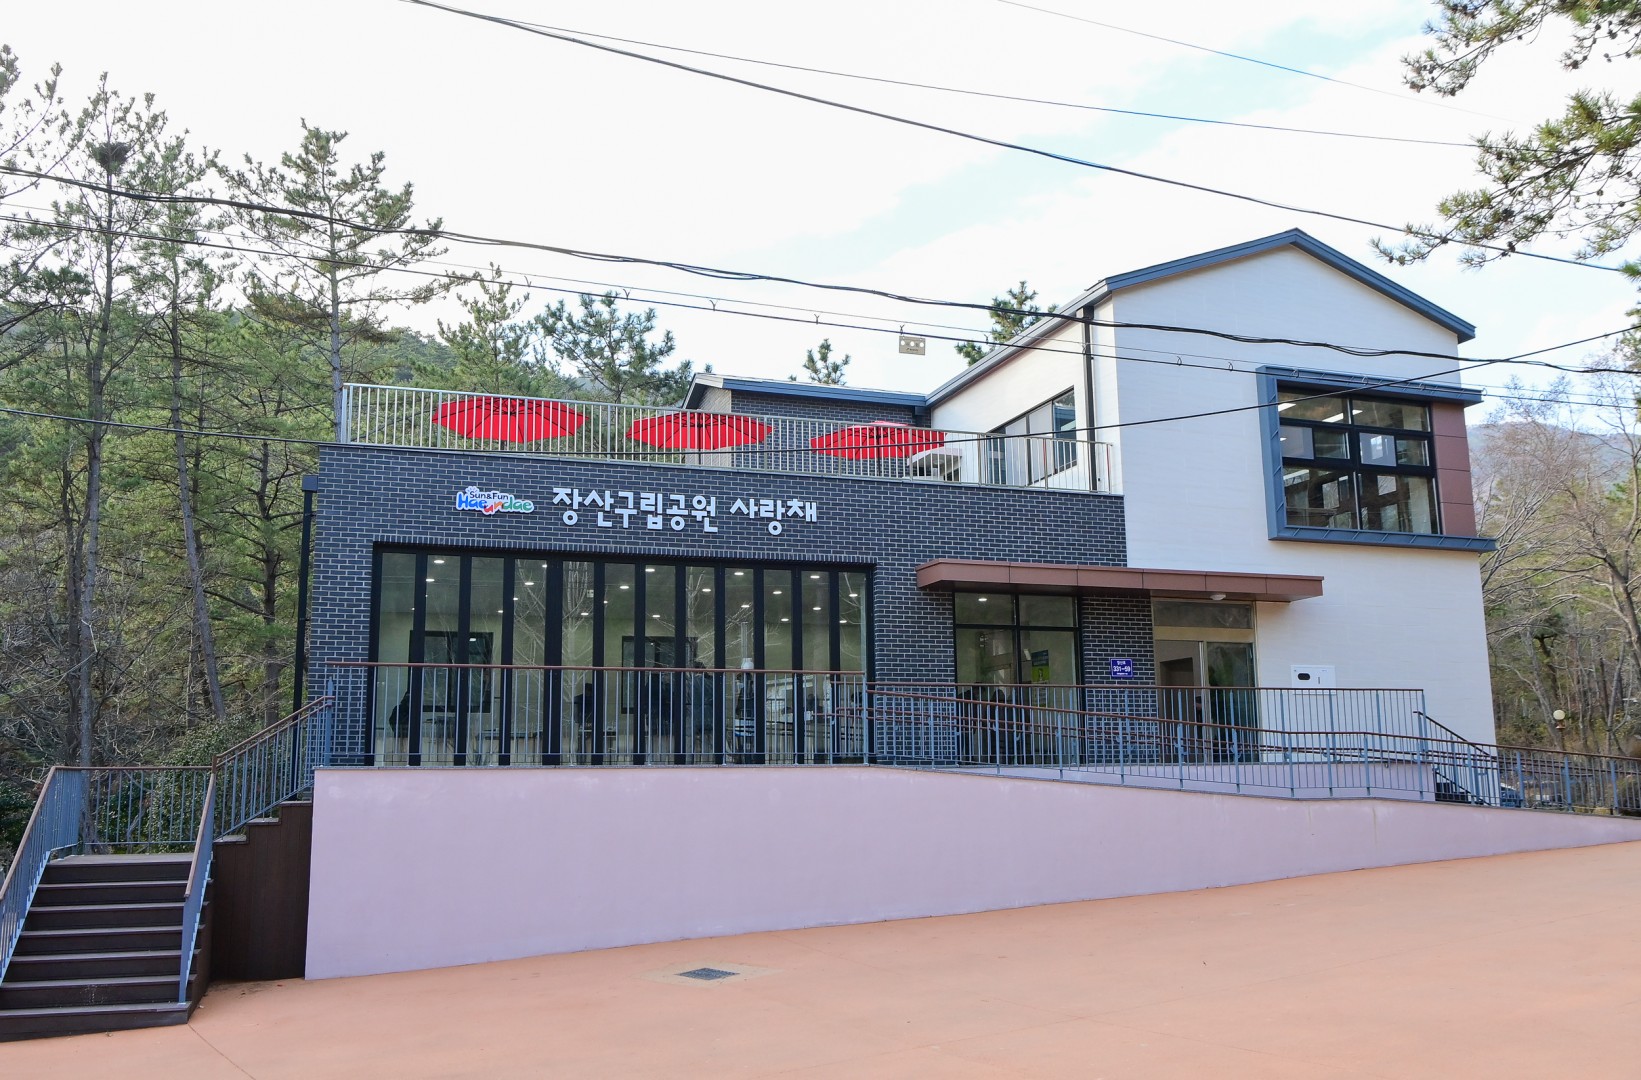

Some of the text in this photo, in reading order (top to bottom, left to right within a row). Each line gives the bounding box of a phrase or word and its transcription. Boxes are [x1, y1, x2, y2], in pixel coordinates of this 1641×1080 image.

[457, 493, 532, 513] Haeundae
[469, 491, 509, 501] Sun&Fun
[552, 487, 817, 536] 장산구립공원 사랑채
